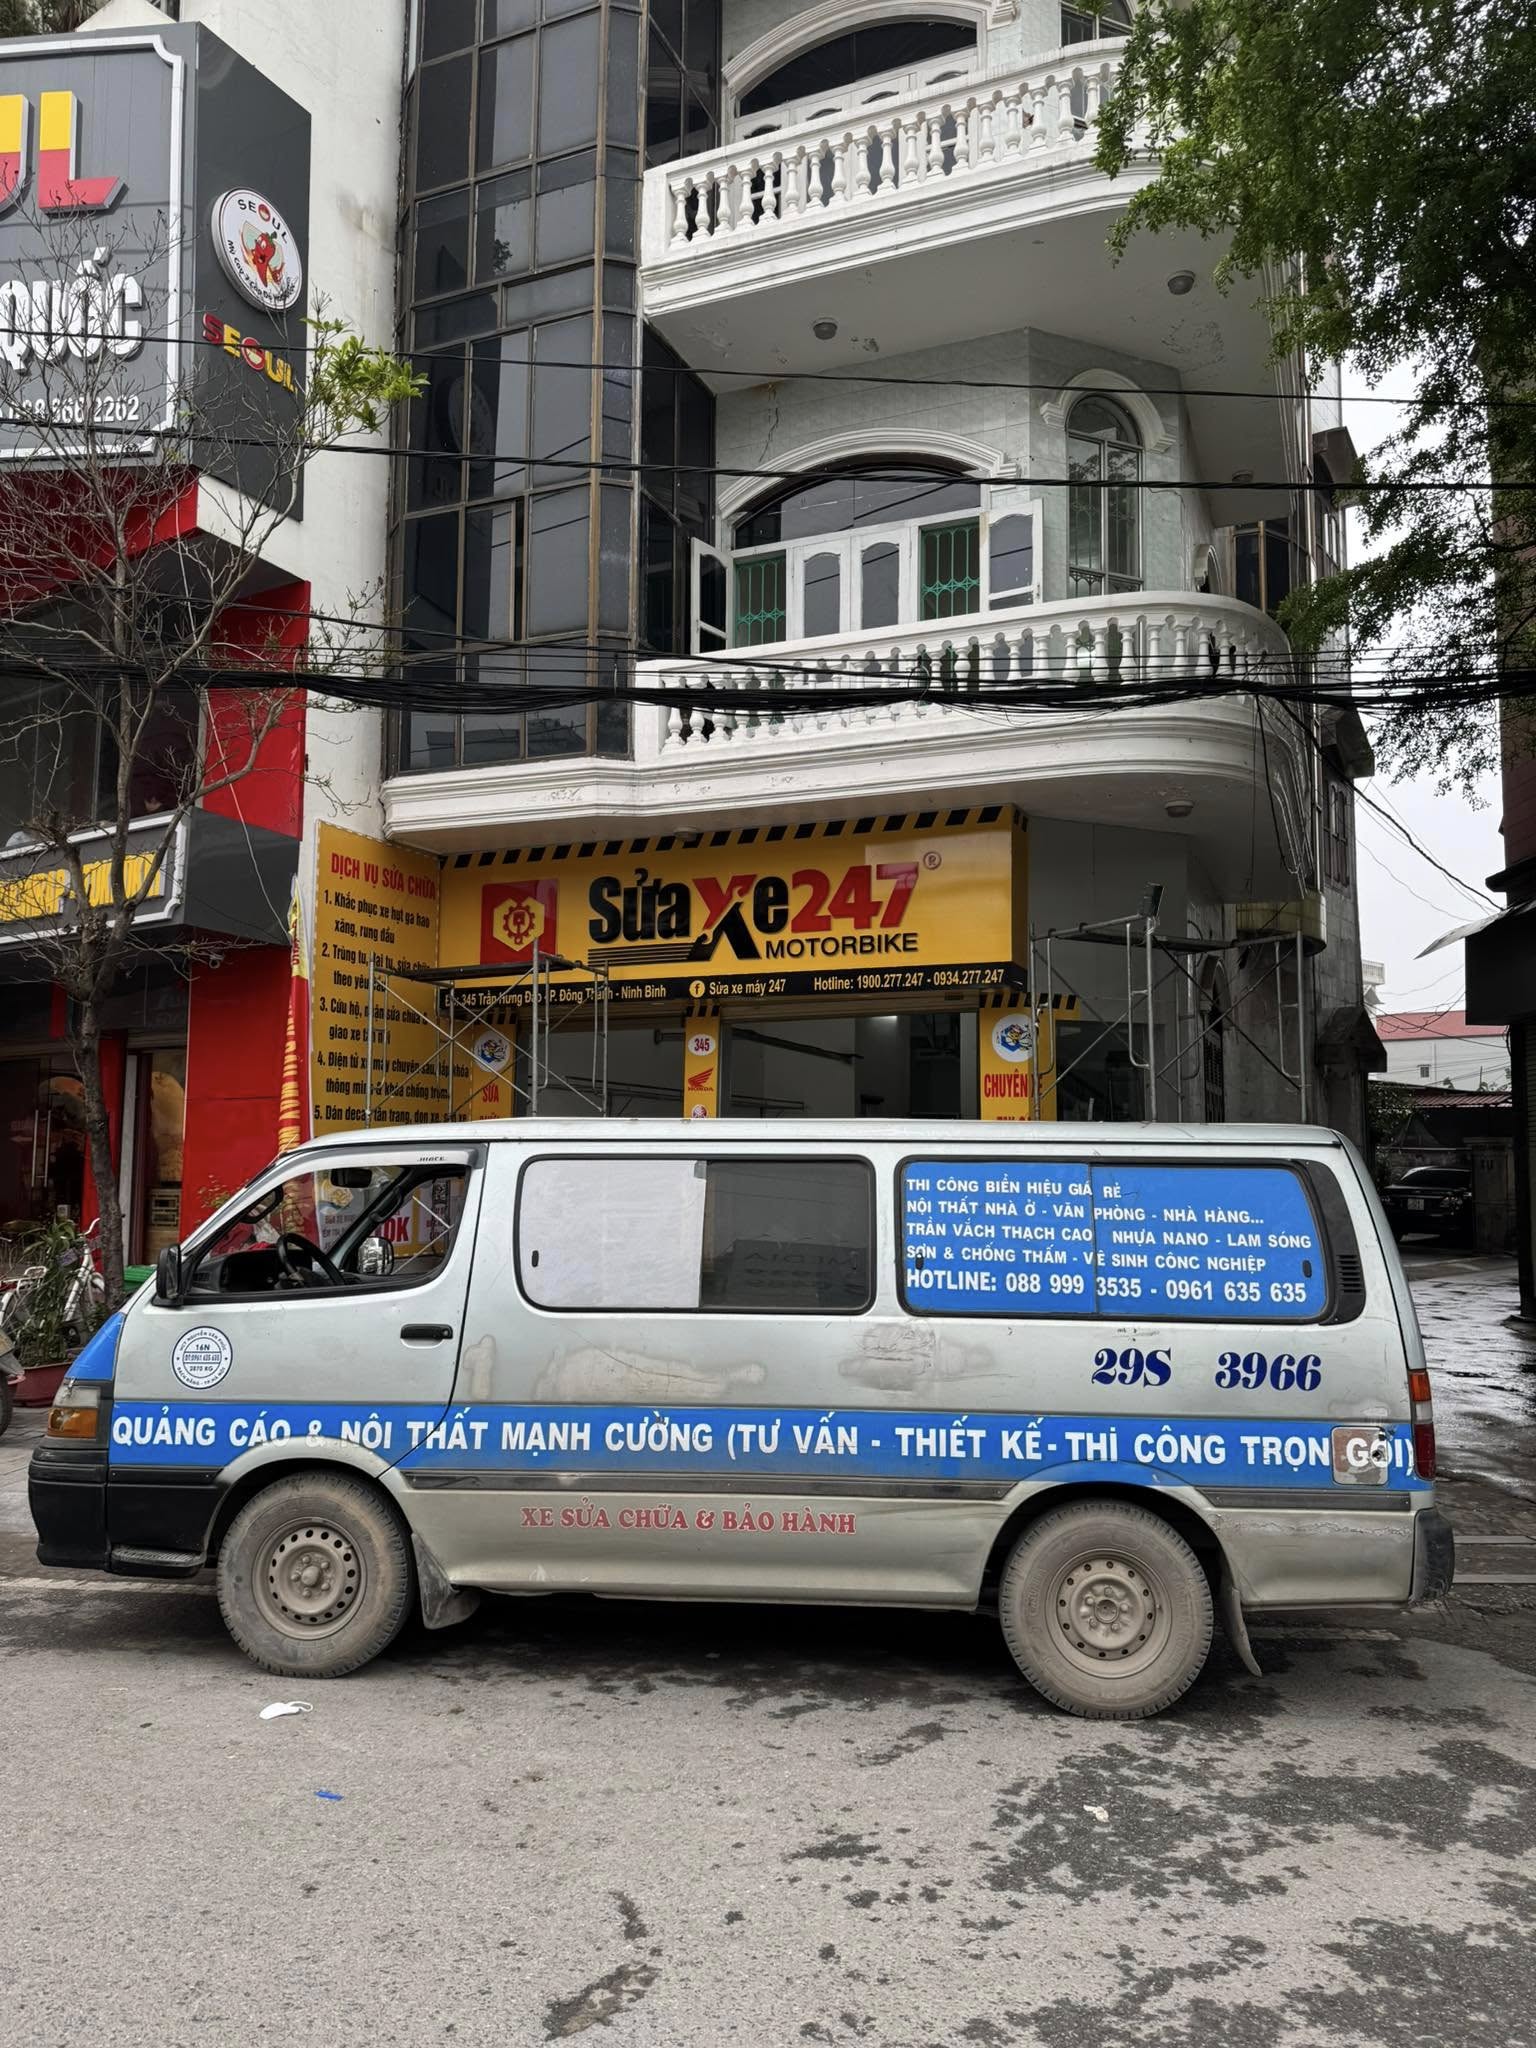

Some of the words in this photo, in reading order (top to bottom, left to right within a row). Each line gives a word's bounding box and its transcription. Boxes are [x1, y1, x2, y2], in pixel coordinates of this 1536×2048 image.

[237, 199, 288, 245] SEOUL
[202, 312, 299, 396] SEOUL
[331, 851, 360, 880] DỊCH
[364, 862, 379, 888] VỤ
[382, 863, 404, 891] SỬA
[324, 889, 332, 904] 1.
[334, 891, 355, 911] Khắc
[358, 898, 378, 918] phục
[379, 906, 389, 918] xe
[405, 912, 415, 926] ga
[416, 913, 430, 929] hao
[360, 925, 378, 941] rung
[765, 932, 919, 960] MOTORBIKE
[321, 942, 330, 957] 2.
[332, 944, 356, 965] Trùng
[334, 969, 353, 986] theo
[708, 980, 729, 996] Sửa
[731, 983, 744, 995] xe
[745, 980, 766, 996] máy
[769, 979, 786, 993] 247
[814, 976, 854, 991] Hotline:
[856, 972, 924, 990] 1900.277.247
[933, 968, 1005, 986] 0934.277.247
[320, 997, 328, 1012] 3.
[461, 993, 476, 1006] 345
[560, 990, 583, 1004] Đông
[621, 986, 642, 999] Ninh
[645, 984, 666, 999] Bình
[329, 1024, 348, 1041] giao
[350, 1027, 361, 1041] xe
[694, 1038, 710, 1051] 345
[317, 1051, 325, 1066] 4.
[328, 1051, 349, 1071] Điện
[326, 1078, 351, 1096] thông
[405, 1083, 429, 1101] chống
[984, 1068, 1028, 1098] CHUYÊN
[314, 1105, 323, 1119] 5.
[325, 1104, 343, 1120] Dán
[906, 1179, 930, 1191] THI
[936, 1177, 979, 1193] CÔNG
[985, 1173, 1020, 1194] BIỂN
[1027, 1179, 1062, 1197] HIỆU
[906, 1197, 932, 1216] NỘI
[938, 1195, 978, 1214] THẤT
[985, 1199, 1018, 1216] NHÀ
[1024, 1199, 1036, 1217] Ở
[1053, 1202, 1084, 1218] VĂN
[1094, 1204, 1145, 1221] PHÒNG
[1163, 1205, 1198, 1222] NHÀ
[1204, 1207, 1264, 1224] HÀNG...
[906, 1216, 946, 1236] TRẦN
[1002, 1226, 1055, 1242] THẠCH
[1061, 1228, 1093, 1241] CAO
[1112, 1229, 1156, 1247] NHỰA
[1163, 1231, 1209, 1246] NANO
[1227, 1233, 1261, 1247] LAM
[1267, 1231, 1311, 1249] SÓNG
[943, 1246, 954, 1260] &
[961, 1241, 1015, 1262] CHỐNG
[1022, 1244, 1067, 1264] THẤM
[1111, 1253, 1148, 1268] SINH
[1207, 1255, 1267, 1274] NGHIỆP
[906, 1268, 997, 1292] HOTLINE:
[1005, 1272, 1041, 1294] 088
[1050, 1274, 1084, 1294] 999
[1096, 1276, 1142, 1298] 3535
[1166, 1279, 1213, 1300] 0961
[1224, 1281, 1261, 1302] 635
[1270, 1282, 1306, 1303] 635
[1091, 1347, 1171, 1388] 29S
[1215, 1351, 1321, 1391] 3966
[112, 1405, 216, 1447] QUẢNG
[229, 1410, 291, 1447] CÁO
[305, 1420, 324, 1448] &
[406, 1407, 489, 1450] THẤT
[501, 1421, 590, 1457] MẠNH
[605, 1411, 713, 1452] CƯỜNG
[727, 1419, 781, 1461] (TƯ
[792, 1411, 858, 1455] VẤN
[895, 1415, 986, 1458] THIẾT
[1134, 1424, 1226, 1465] CÔNG
[1239, 1435, 1331, 1472] TRỌN
[520, 1507, 554, 1527] XE
[560, 1496, 611, 1529] SỬA
[618, 1502, 689, 1530] CHỮA
[695, 1510, 714, 1530] &
[721, 1502, 776, 1531] BẢO
[781, 1506, 856, 1534] HÀNH
